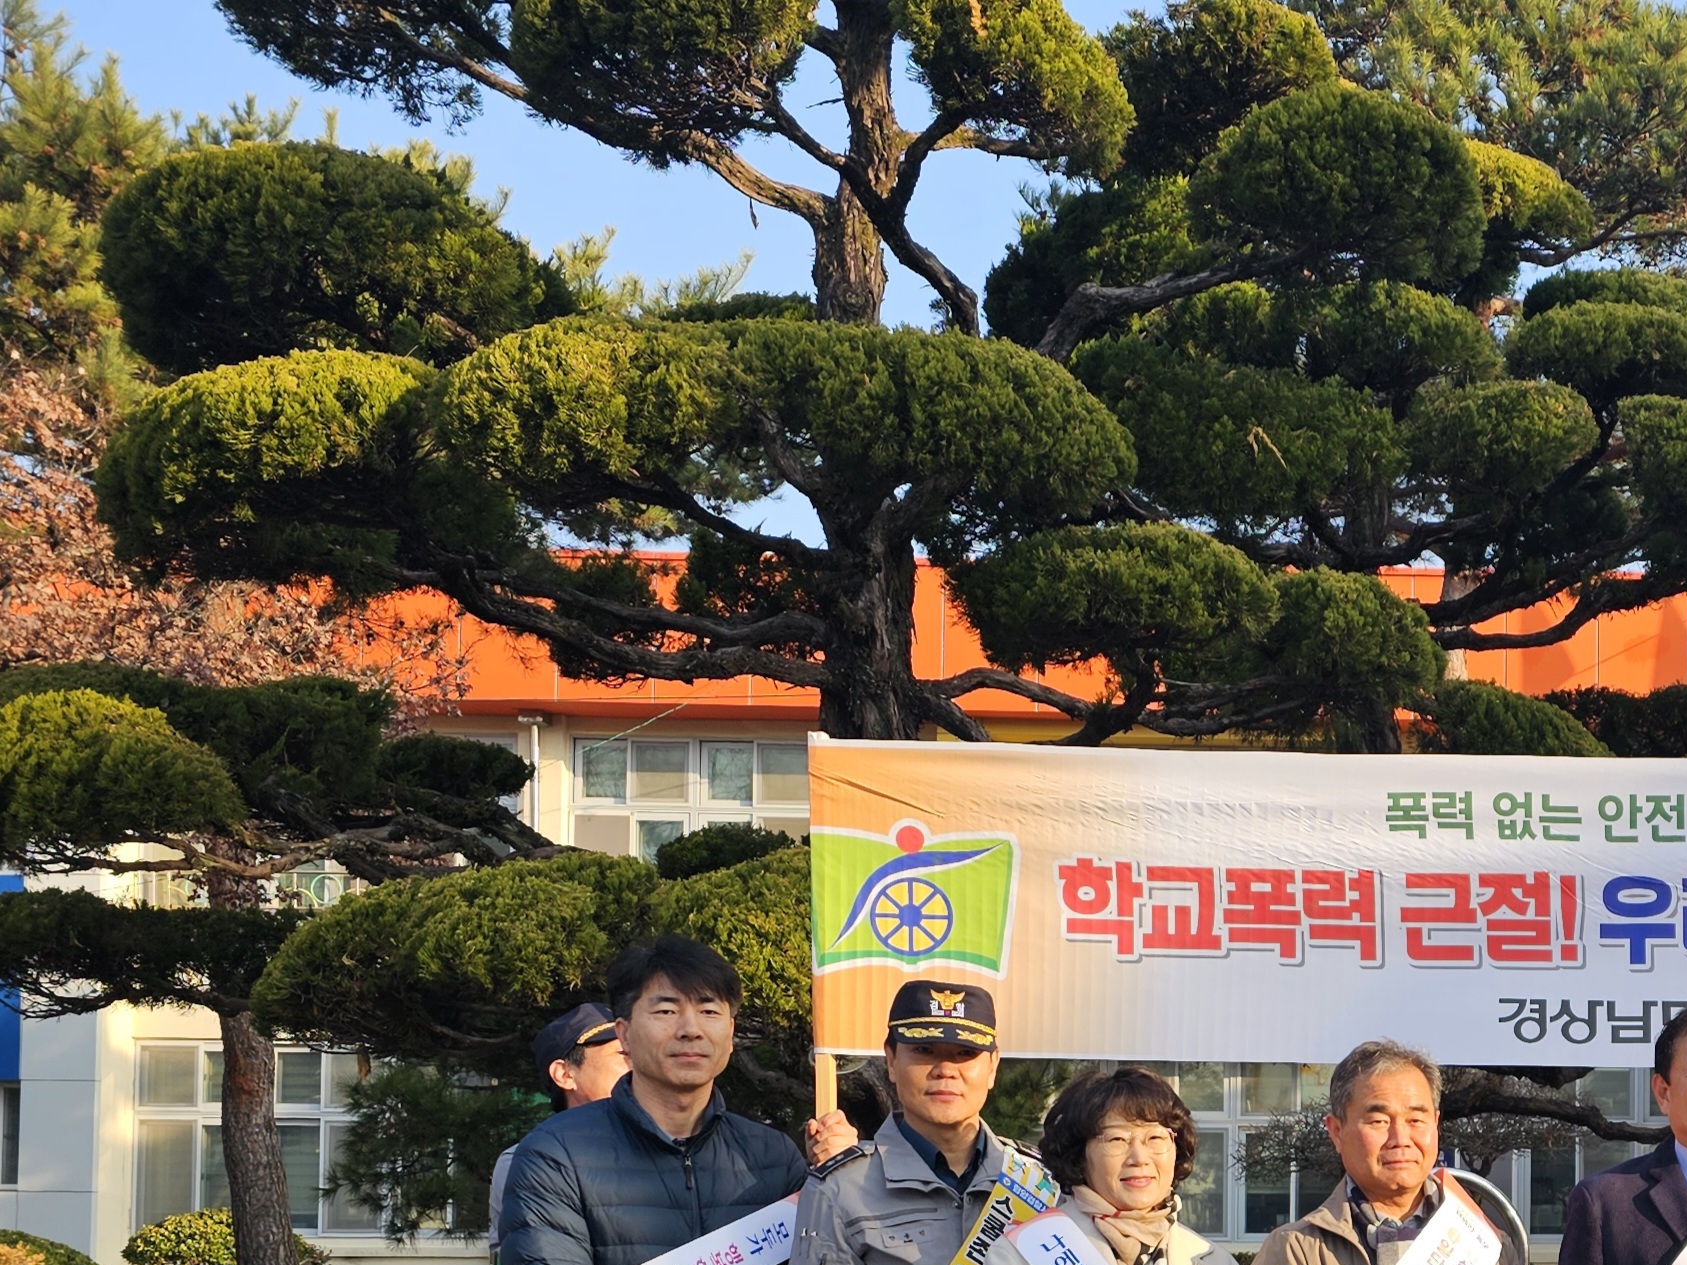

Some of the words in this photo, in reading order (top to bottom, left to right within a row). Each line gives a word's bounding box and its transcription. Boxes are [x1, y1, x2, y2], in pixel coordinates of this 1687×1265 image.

[1385, 791, 1474, 840] 폭력
[1492, 793, 1582, 843] 없는
[1057, 857, 1377, 961] 학교폭력
[1400, 871, 1580, 964] 근절!
[747, 1221, 790, 1255] 모두가
[966, 1196, 1014, 1265] 스쿨존
